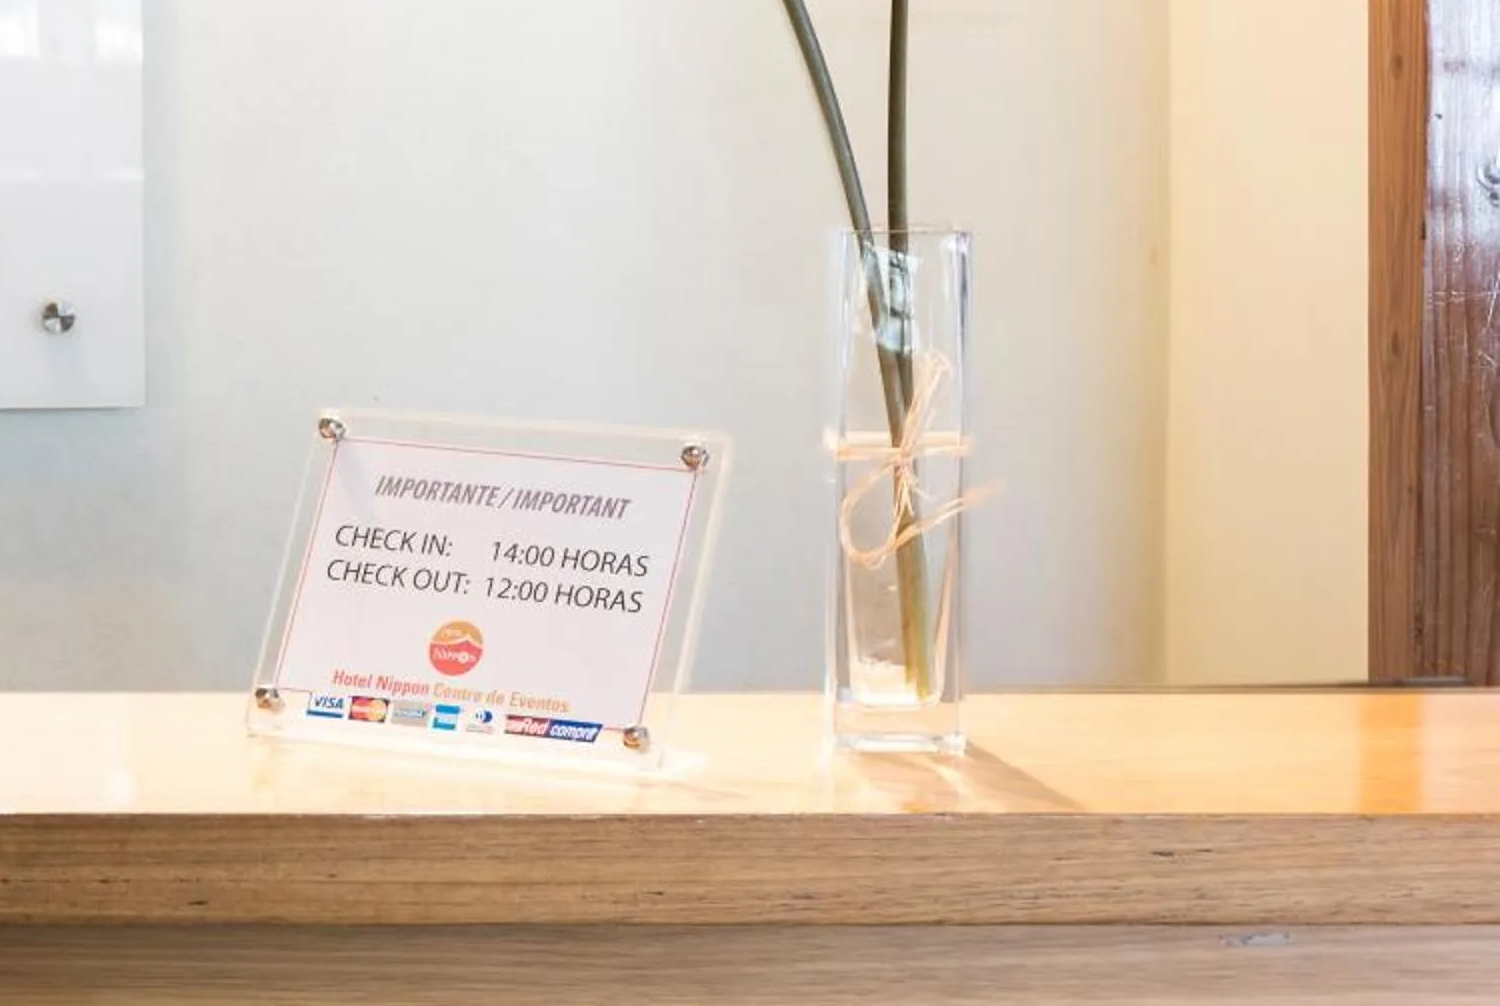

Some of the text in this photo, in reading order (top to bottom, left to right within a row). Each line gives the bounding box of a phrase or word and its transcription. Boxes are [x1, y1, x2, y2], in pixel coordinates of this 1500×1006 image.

[335, 524, 649, 577] CHECK IN: 14:00 HORAS
[327, 559, 644, 613] CHECK OUT: 12:00 HORAS
[332, 669, 373, 688] Hotel
[376, 675, 429, 696] Nippon
[314, 696, 344, 710] VISA
